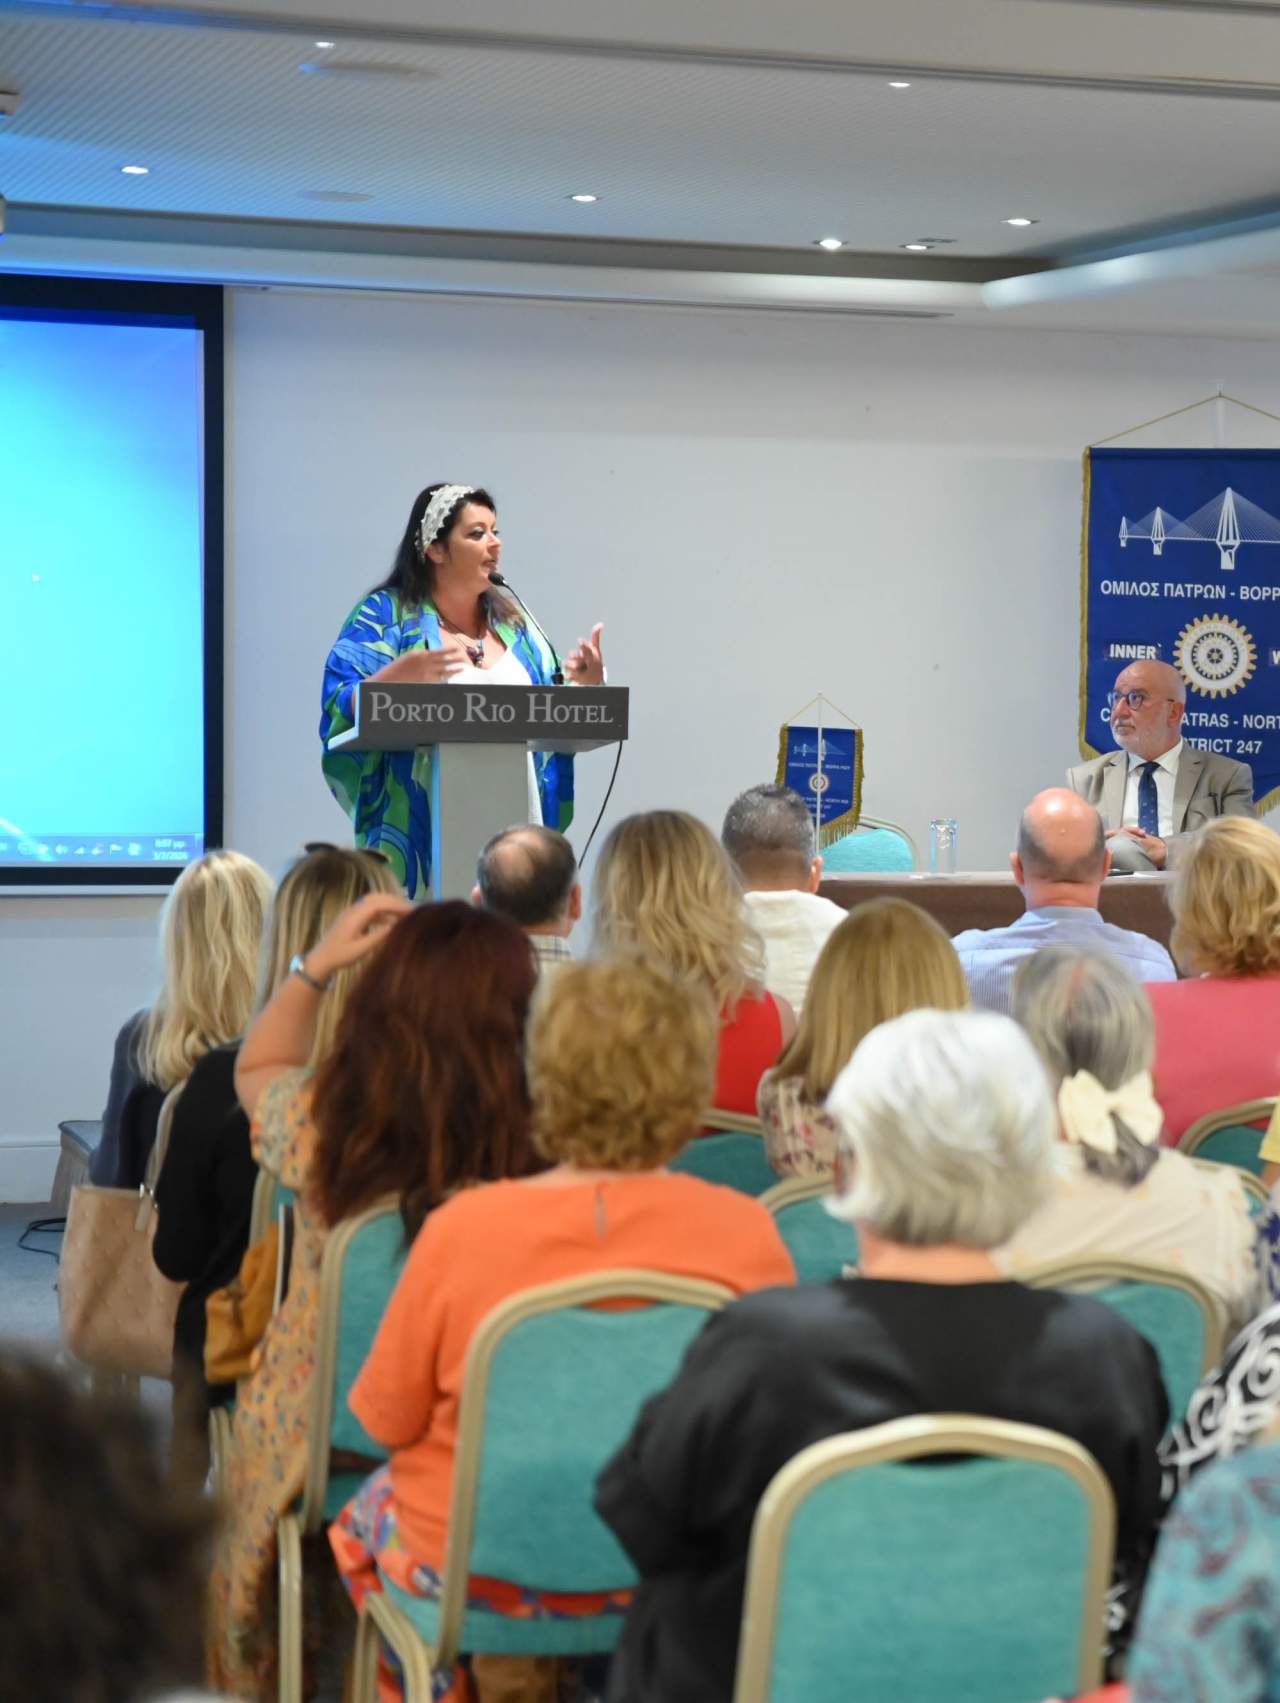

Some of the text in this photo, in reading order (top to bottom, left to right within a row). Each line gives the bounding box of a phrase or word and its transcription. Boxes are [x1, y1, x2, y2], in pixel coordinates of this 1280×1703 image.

[1100, 579, 1160, 597] ΟΜΙΛΟΣ
[1163, 582, 1226, 600] ΠΑΤΡΩΝ
[1109, 643, 1156, 660] INNER
[1180, 712, 1230, 728] ATRAS
[1184, 737, 1263, 754] TRICT 247
